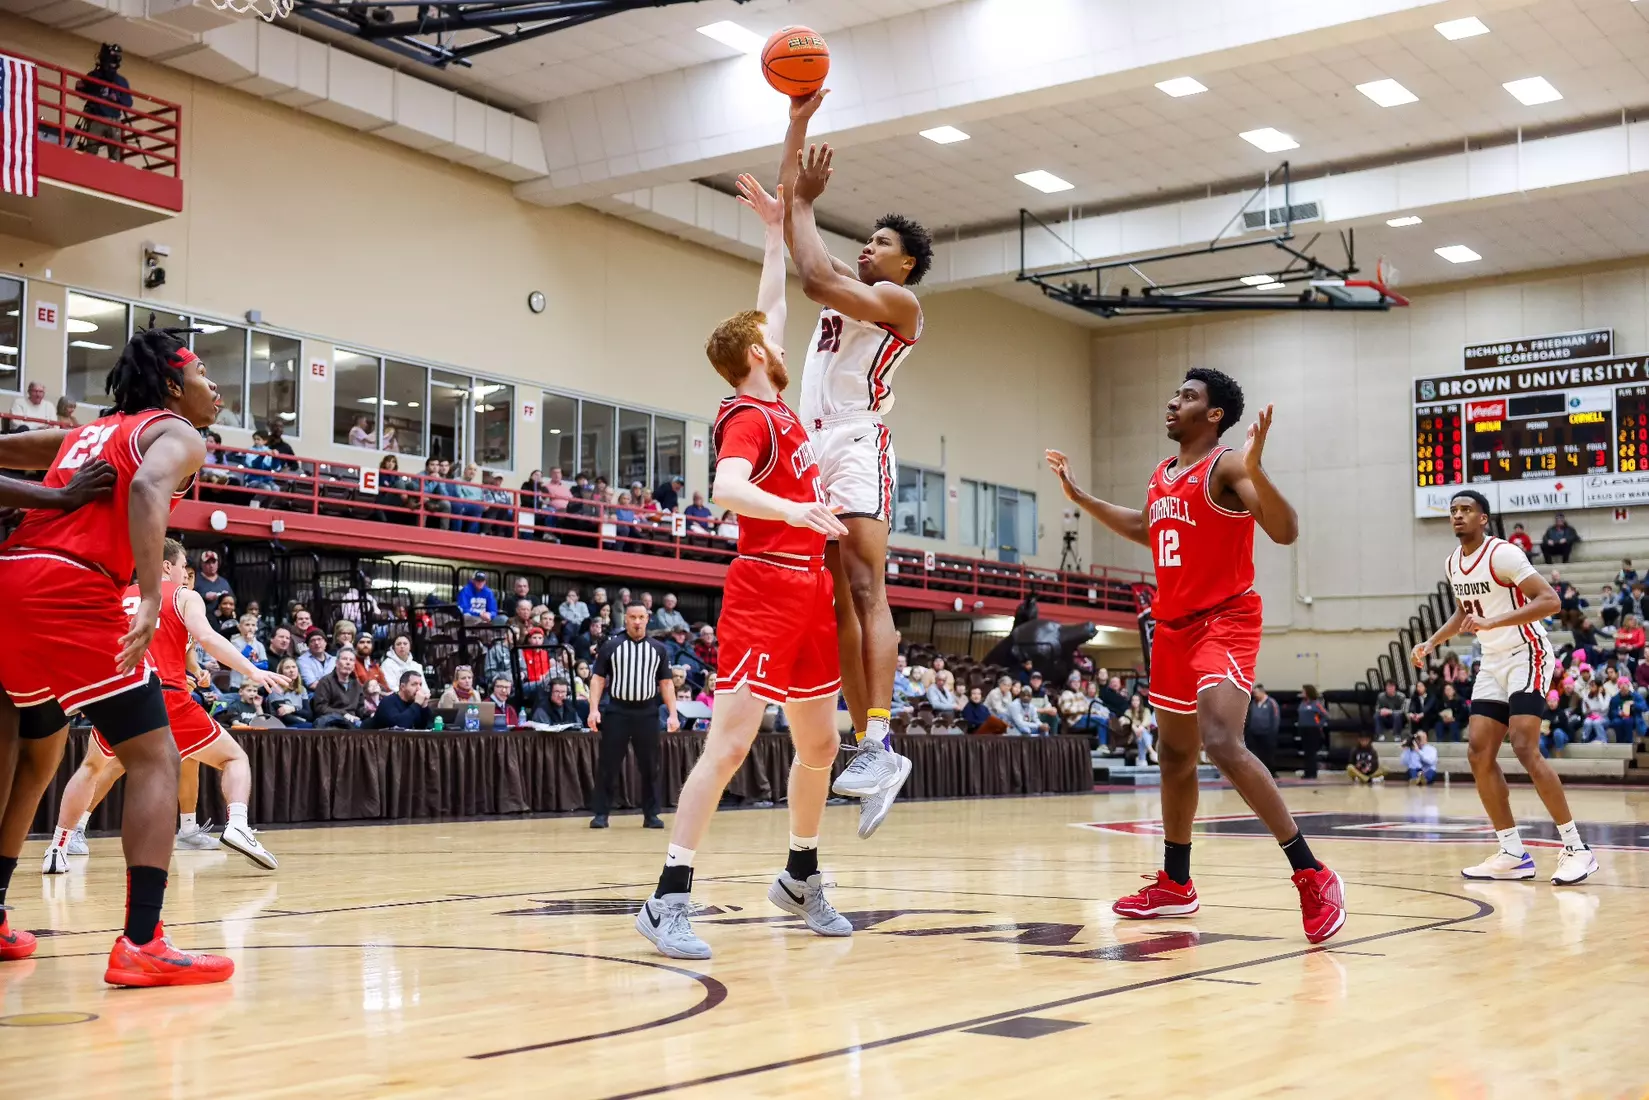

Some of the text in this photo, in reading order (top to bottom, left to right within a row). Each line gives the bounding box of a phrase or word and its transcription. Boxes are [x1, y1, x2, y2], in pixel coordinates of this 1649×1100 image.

[38, 307, 55, 323] EE
[1465, 344, 1513, 358] RICHARD
[1516, 342, 1527, 352] A.
[1531, 335, 1587, 351] FRIEDMAN
[1497, 348, 1571, 365] SCOREBOARD
[311, 363, 325, 377] EE
[1439, 361, 1638, 397] BROWN UNIVERSITY
[524, 405, 534, 416] FF
[1568, 411, 1605, 425] CORNELL
[58, 424, 119, 469] 21
[1499, 458, 1510, 472] 4
[1567, 453, 1578, 467] 4
[364, 471, 376, 489] E
[1509, 493, 1571, 507] SHAWMUT
[1149, 496, 1197, 528] CORNELL
[1615, 508, 1627, 520] H
[675, 517, 683, 532] F
[1158, 529, 1182, 567] 12
[1453, 581, 1491, 596] BROWN
[756, 653, 770, 679] C
